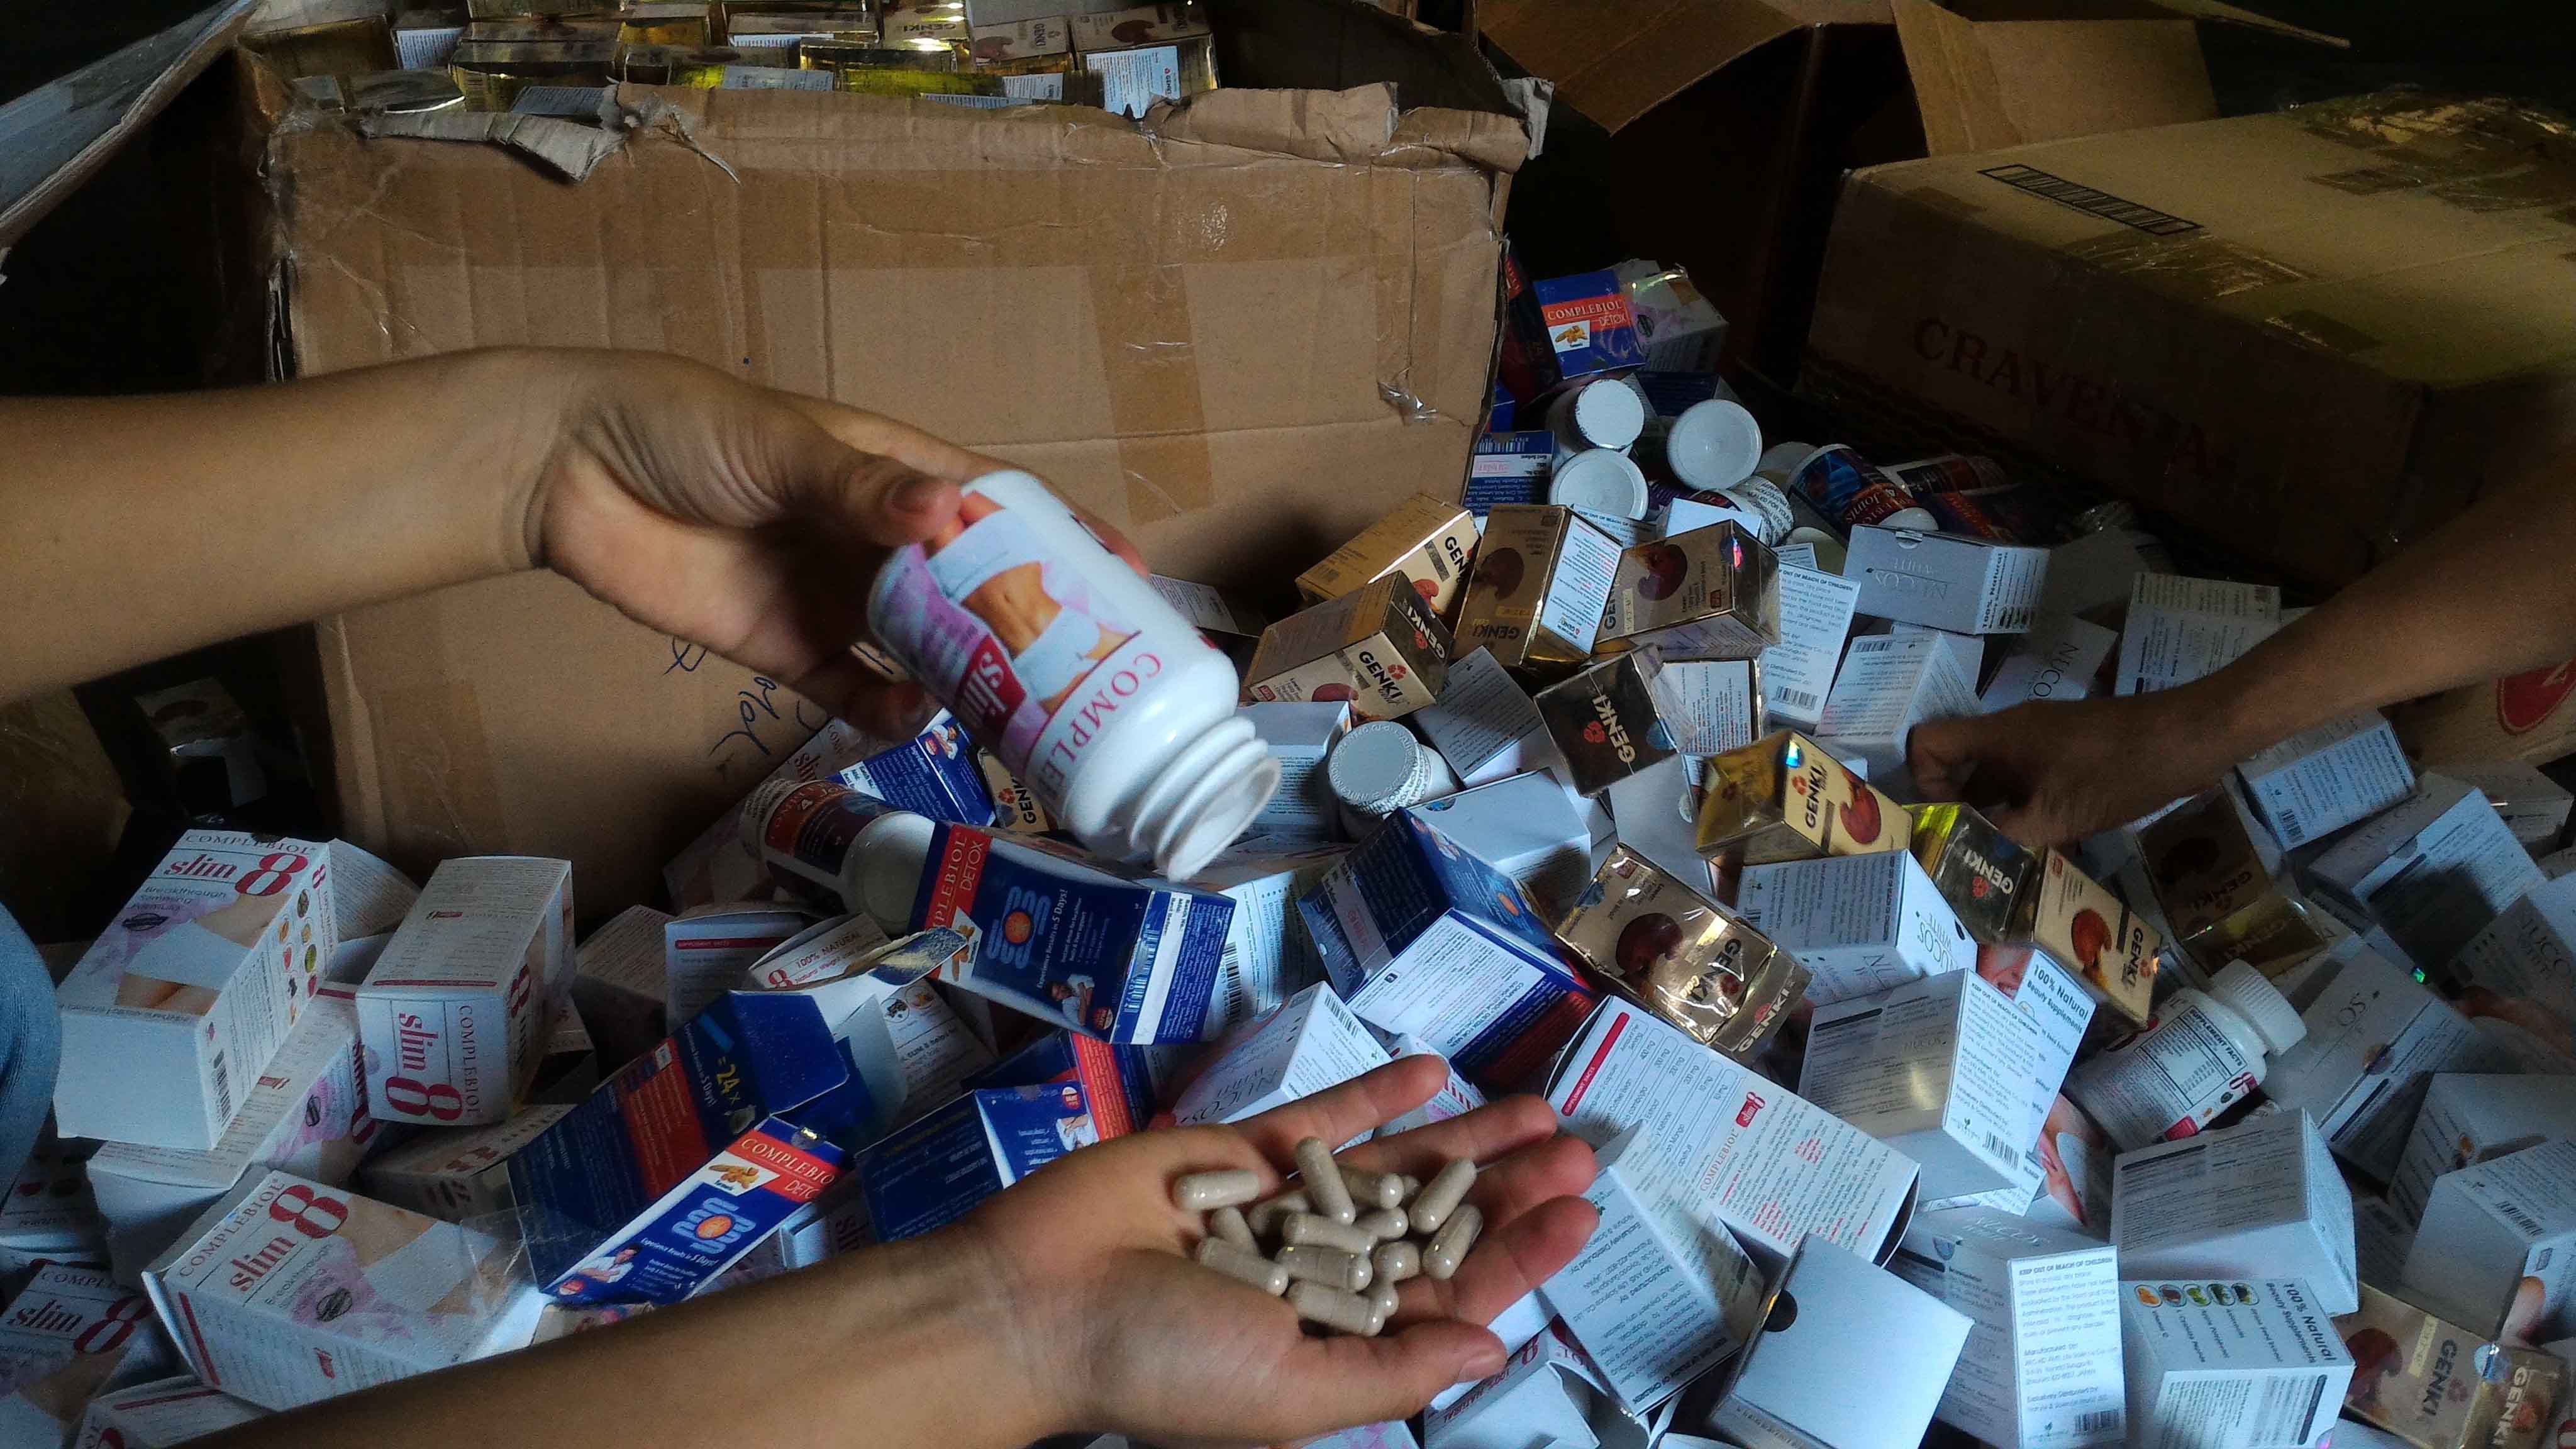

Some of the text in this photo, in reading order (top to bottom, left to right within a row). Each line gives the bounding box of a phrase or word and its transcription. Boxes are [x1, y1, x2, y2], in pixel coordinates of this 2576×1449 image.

[1546, 298, 1623, 322] COMPLEBIOL
[1982, 553, 2002, 628] 100% Natural
[1406, 605, 1446, 660] GENKI
[1358, 650, 1403, 701] GENKI
[1592, 695, 1636, 763] GENKI
[1805, 762, 1824, 829] GENKI
[185, 833, 313, 853] COMPLEBIOL
[958, 840, 987, 892] DETOX
[1963, 848, 2014, 896] GENKI
[164, 852, 308, 897] slim 8
[933, 833, 969, 928] PLEBIOL
[1053, 888, 1070, 915] Days!
[2125, 926, 2143, 987] GENKI
[1738, 987, 1791, 1053] GENKI
[2026, 979, 2083, 1036] Beauty Supplements
[2032, 964, 2089, 1021] 100% Natural
[384, 1011, 464, 1121] slim 8
[457, 1004, 481, 1118] COMPLEBIOL
[2189, 1008, 2243, 1067] SUPPLEMENT FACTS
[1644, 1097, 1660, 1119] Extract
[1668, 1123, 1685, 1145] Mango
[740, 1137, 835, 1186] COMPLEBIO
[1698, 1129, 1740, 1194] COMPLEBIOL
[179, 1178, 287, 1279] COMPLEBIOL
[228, 1184, 350, 1292] slim 8
[8, 1298, 84, 1333] slim
[72, 1294, 154, 1354] 8
[2282, 1311, 2316, 1363] Supplements
[2283, 1283, 2336, 1360] 100% Natural
[2421, 1338, 2458, 1418] GENKI
[2493, 1366, 2532, 1449] GENKI
